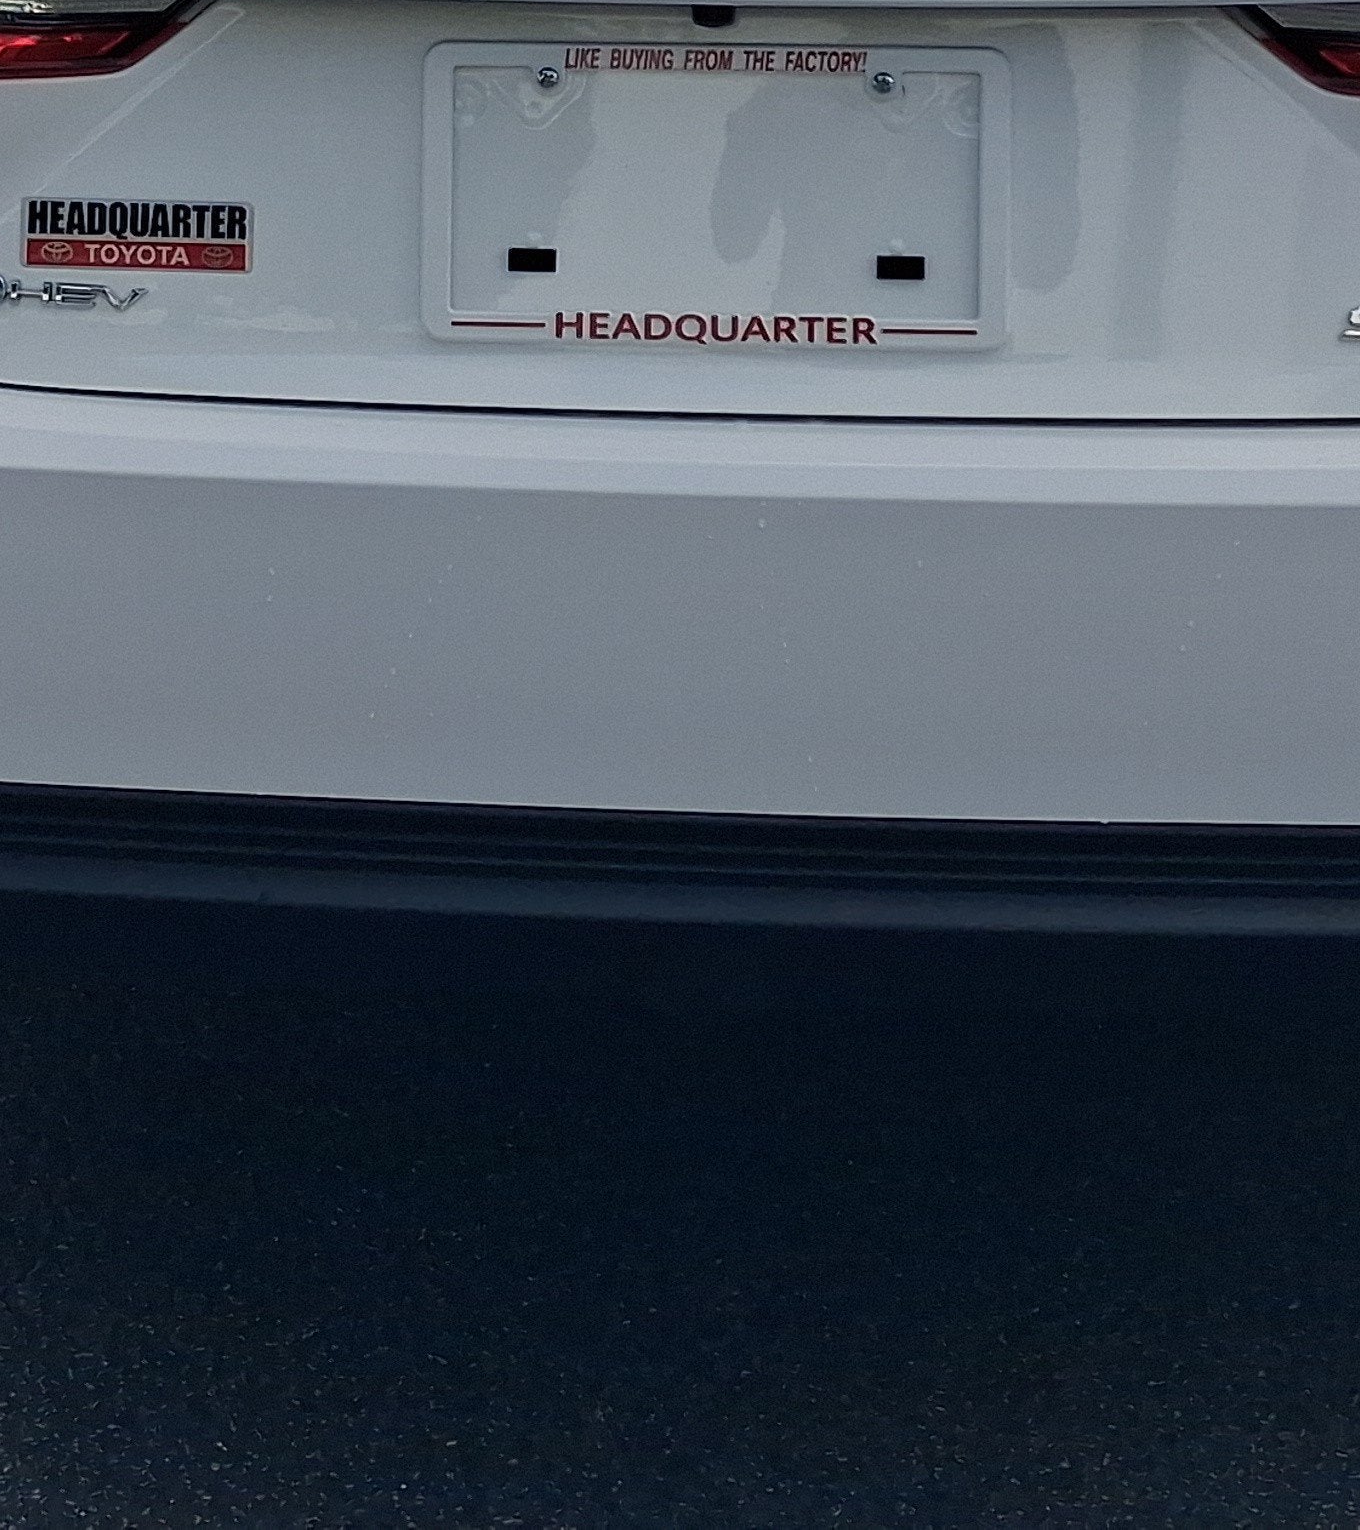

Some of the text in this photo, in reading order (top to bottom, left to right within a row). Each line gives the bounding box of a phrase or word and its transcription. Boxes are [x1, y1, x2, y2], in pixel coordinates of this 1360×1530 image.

[564, 47, 868, 73] LIKE BUYING FROM THE FACTORY!
[28, 200, 247, 240] HEADQUARTER
[84, 243, 191, 266] TOYOTA
[554, 311, 879, 346] HEADQUARTER
